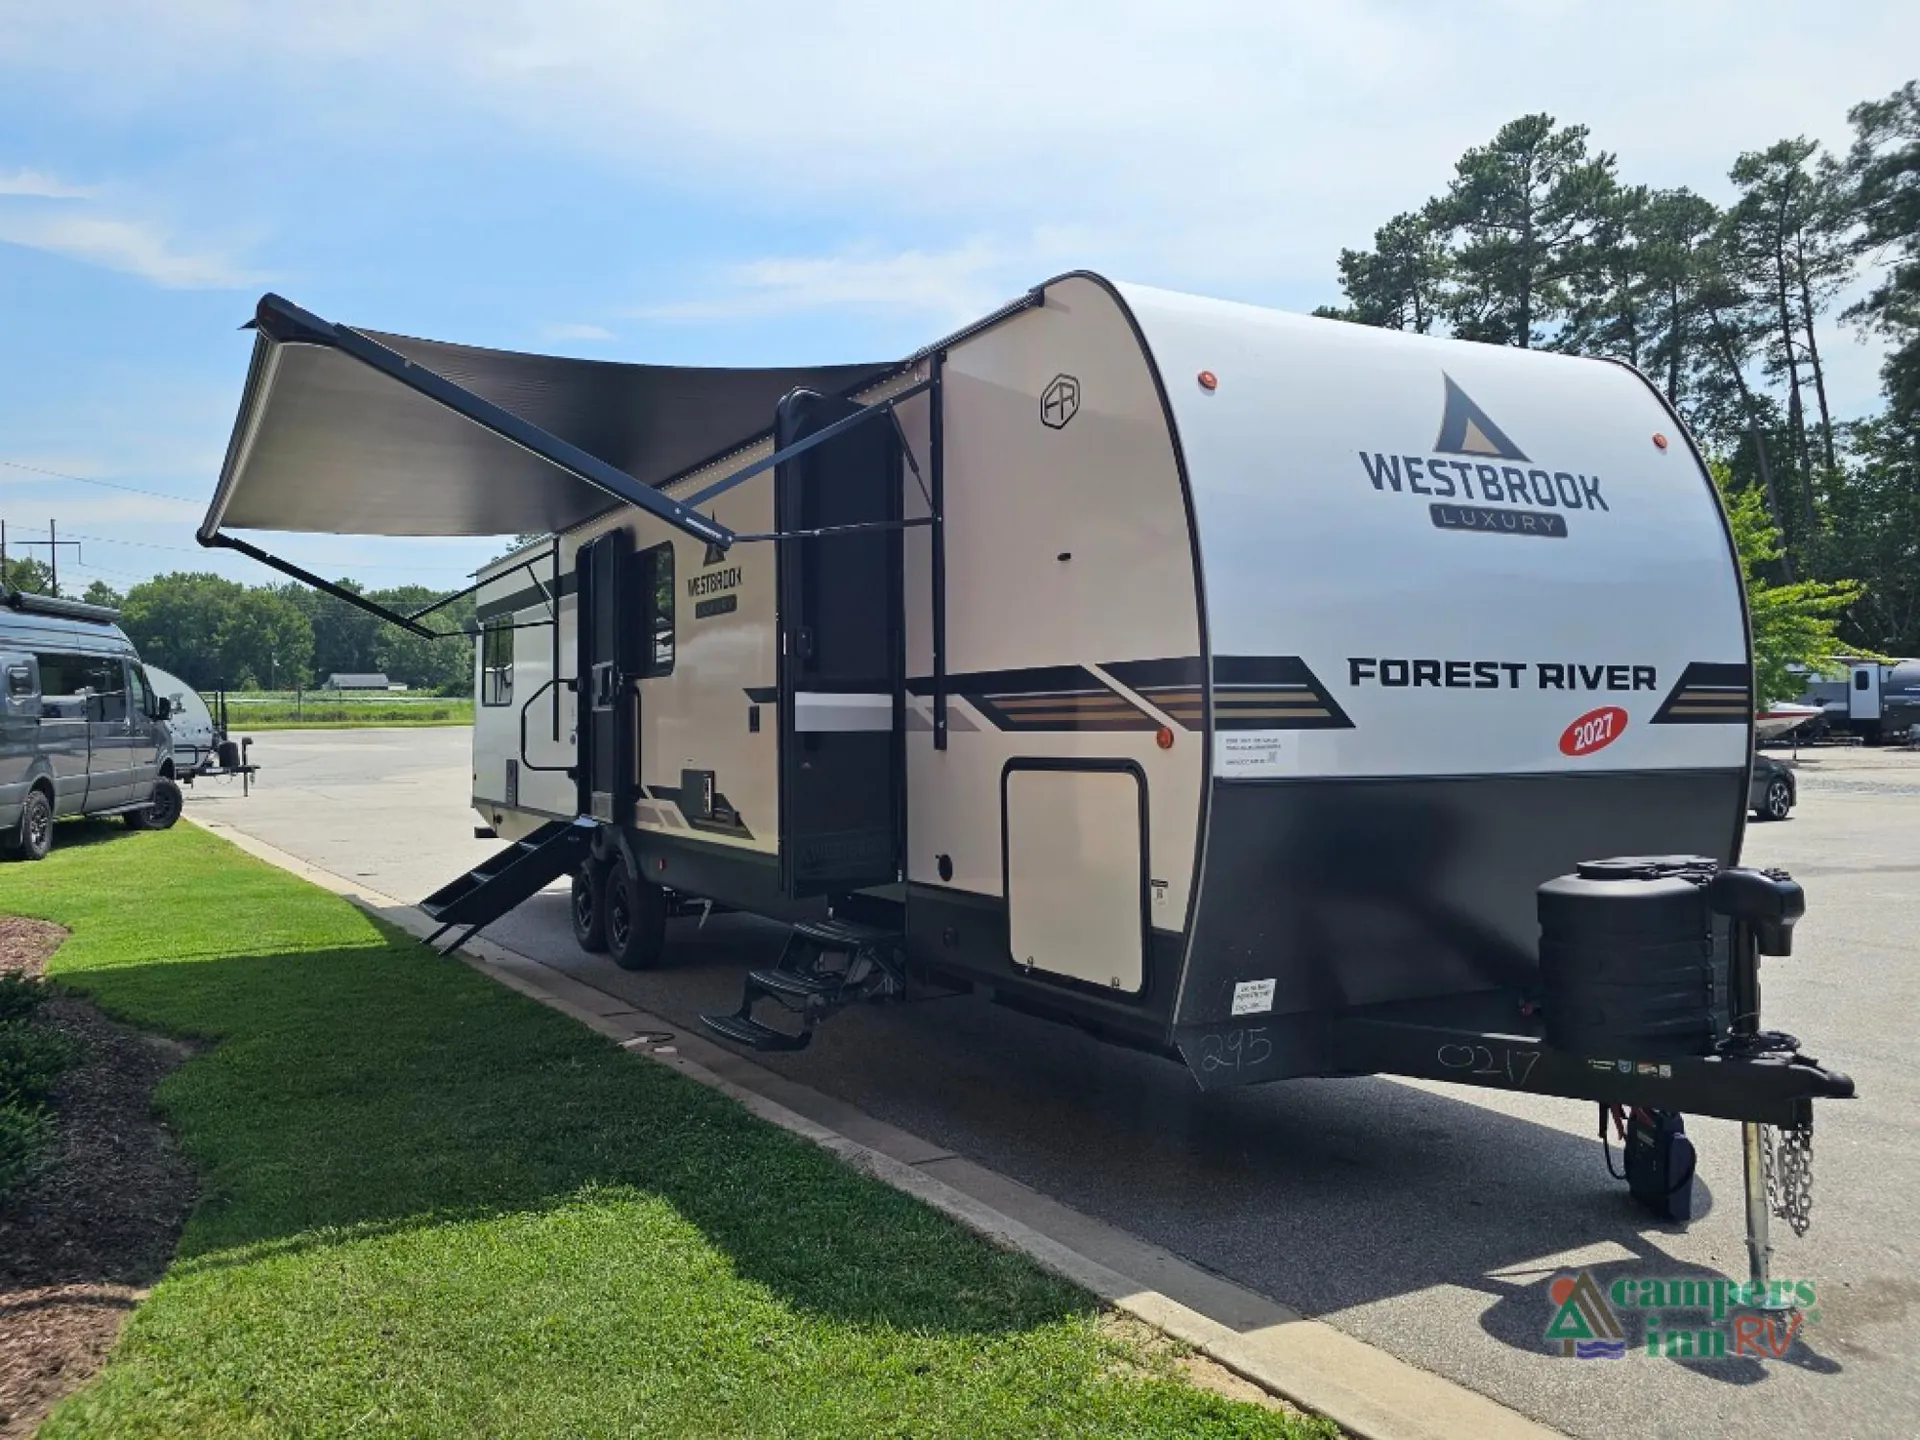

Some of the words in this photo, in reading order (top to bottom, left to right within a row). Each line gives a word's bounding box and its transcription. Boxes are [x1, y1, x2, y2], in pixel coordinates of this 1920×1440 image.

[1358, 451, 1610, 512] WESTBROOK
[1439, 507, 1556, 533] LUXURY
[1347, 657, 1527, 690] FOREST
[1536, 663, 1657, 691] RIVER
[1574, 711, 1614, 751] 2027
